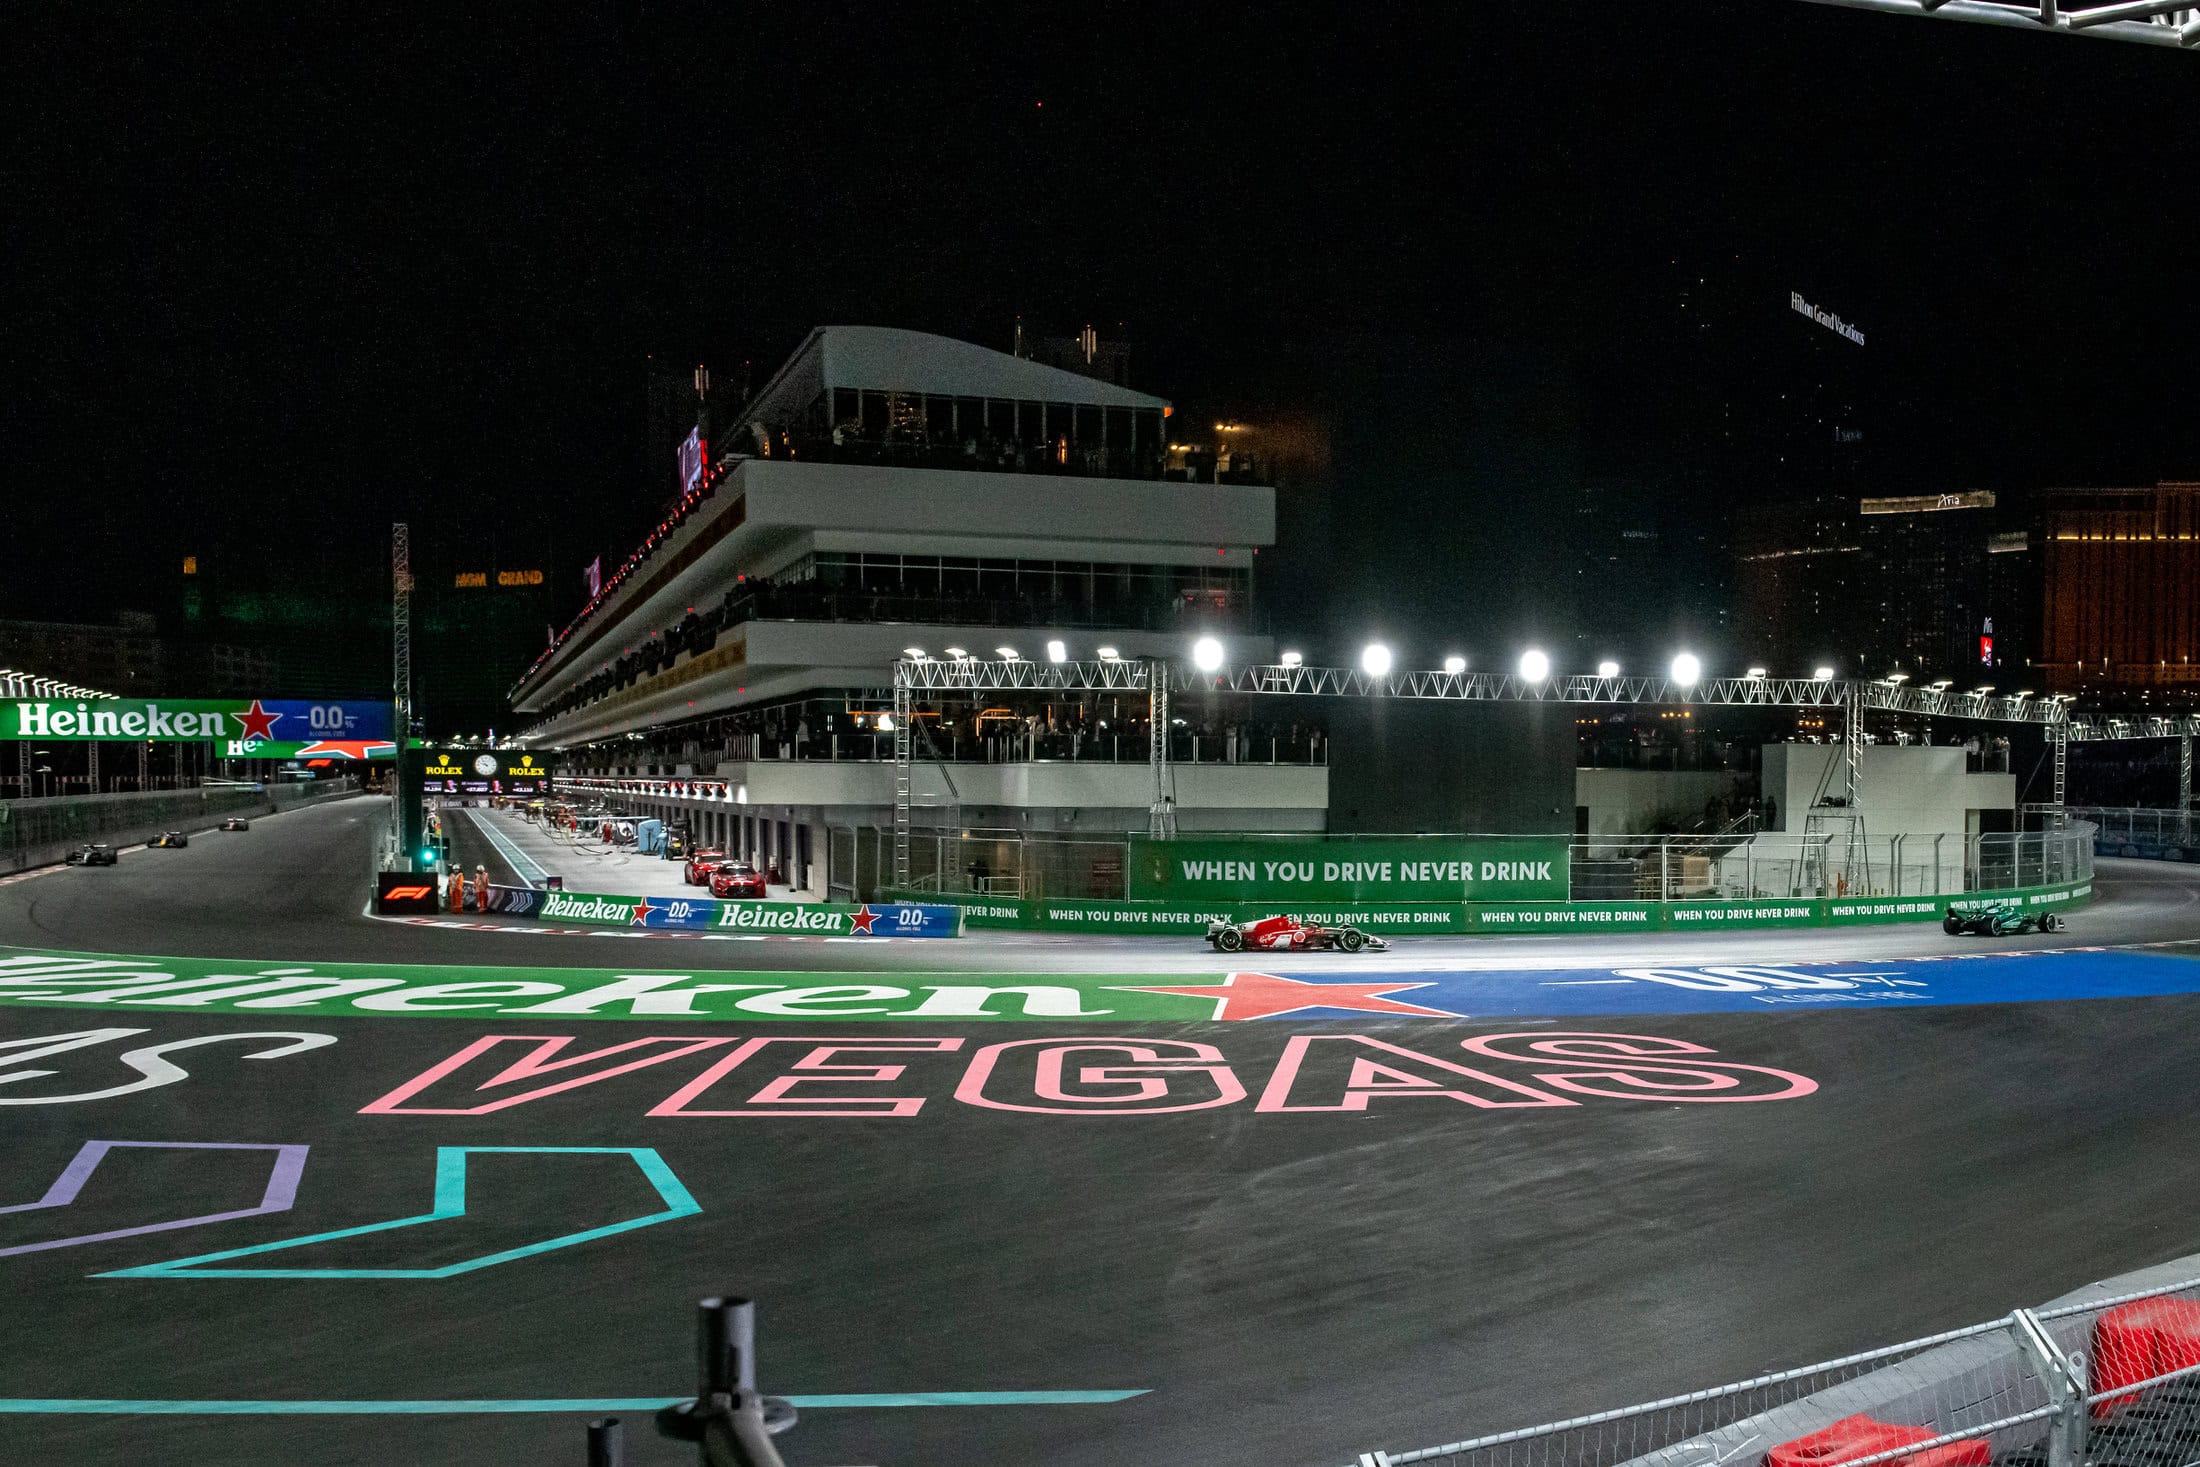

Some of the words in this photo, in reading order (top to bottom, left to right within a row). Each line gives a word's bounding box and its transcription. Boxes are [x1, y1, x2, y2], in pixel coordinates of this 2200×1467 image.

[1791, 291, 1814, 319] Hilton
[1814, 304, 1835, 331] Grand
[1834, 314, 1865, 346] Vacations
[498, 570, 543, 586] GRAND
[17, 703, 227, 737] Heineken
[425, 766, 463, 775] ROLEX
[509, 767, 545, 776] ROLEX
[1182, 860, 1257, 882] WHEN
[1263, 861, 1315, 882] YOU
[1323, 862, 1393, 882] DRIVE
[1401, 862, 1474, 882] NEVER
[1481, 861, 1552, 881] DRINK
[384, 886, 432, 900] F1
[541, 893, 629, 920] Heineken
[966, 907, 988, 917] EVER
[990, 907, 1019, 919] DRINK
[1674, 909, 1703, 921] WHEN
[1704, 909, 1725, 920] YOU
[1727, 908, 1754, 920] DRIVE
[1755, 907, 1782, 919] NEVER
[1783, 906, 1811, 918] DRINK
[1832, 905, 1855, 916] WHEN
[1856, 905, 1872, 915] YOU
[1874, 904, 1895, 914] DRIVE
[1896, 903, 1916, 913] NEVER
[1917, 902, 1936, 912] DRINK
[718, 903, 842, 930] Heineken
[1049, 909, 1084, 921] WHEN
[1086, 910, 1111, 922] YOU
[1113, 911, 1149, 923] DRIVE
[1151, 912, 1190, 924] NEVER
[1305, 913, 1332, 924] YOU
[1335, 913, 1370, 924] DRIVE
[1375, 912, 1411, 924] NEVER
[1413, 912, 1451, 923] DRINK
[1481, 912, 1515, 923] WHEN
[1517, 912, 1542, 922] YOU
[1544, 911, 1576, 922] DRIVE
[1578, 911, 1612, 922] NEVER
[1614, 910, 1647, 921] DRINK
[357, 1032, 1820, 1118] VEGAS
